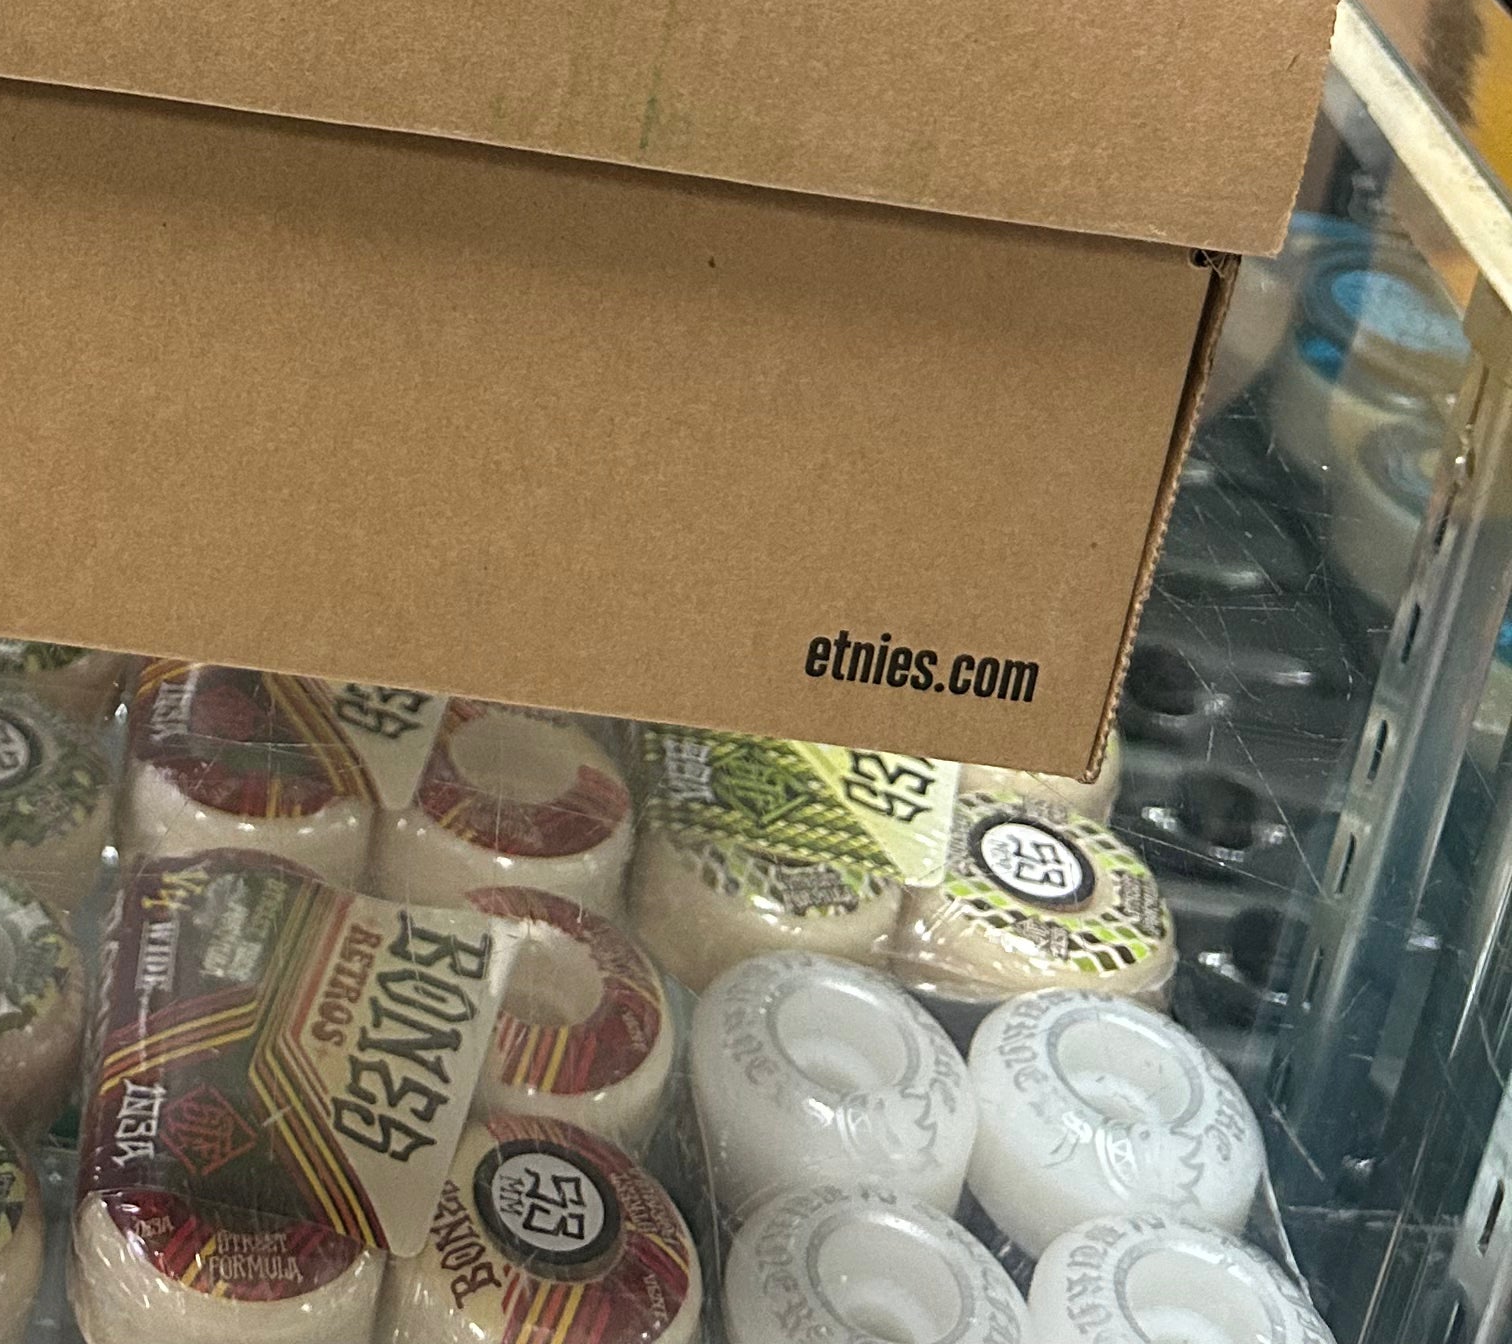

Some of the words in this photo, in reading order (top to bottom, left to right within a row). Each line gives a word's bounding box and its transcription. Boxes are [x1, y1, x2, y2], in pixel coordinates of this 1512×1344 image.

[804, 629, 1040, 703] etnies.com
[310, 922, 382, 1048] RETROS
[331, 912, 493, 1164] BONES
[207, 1254, 305, 1285] FORMULA
